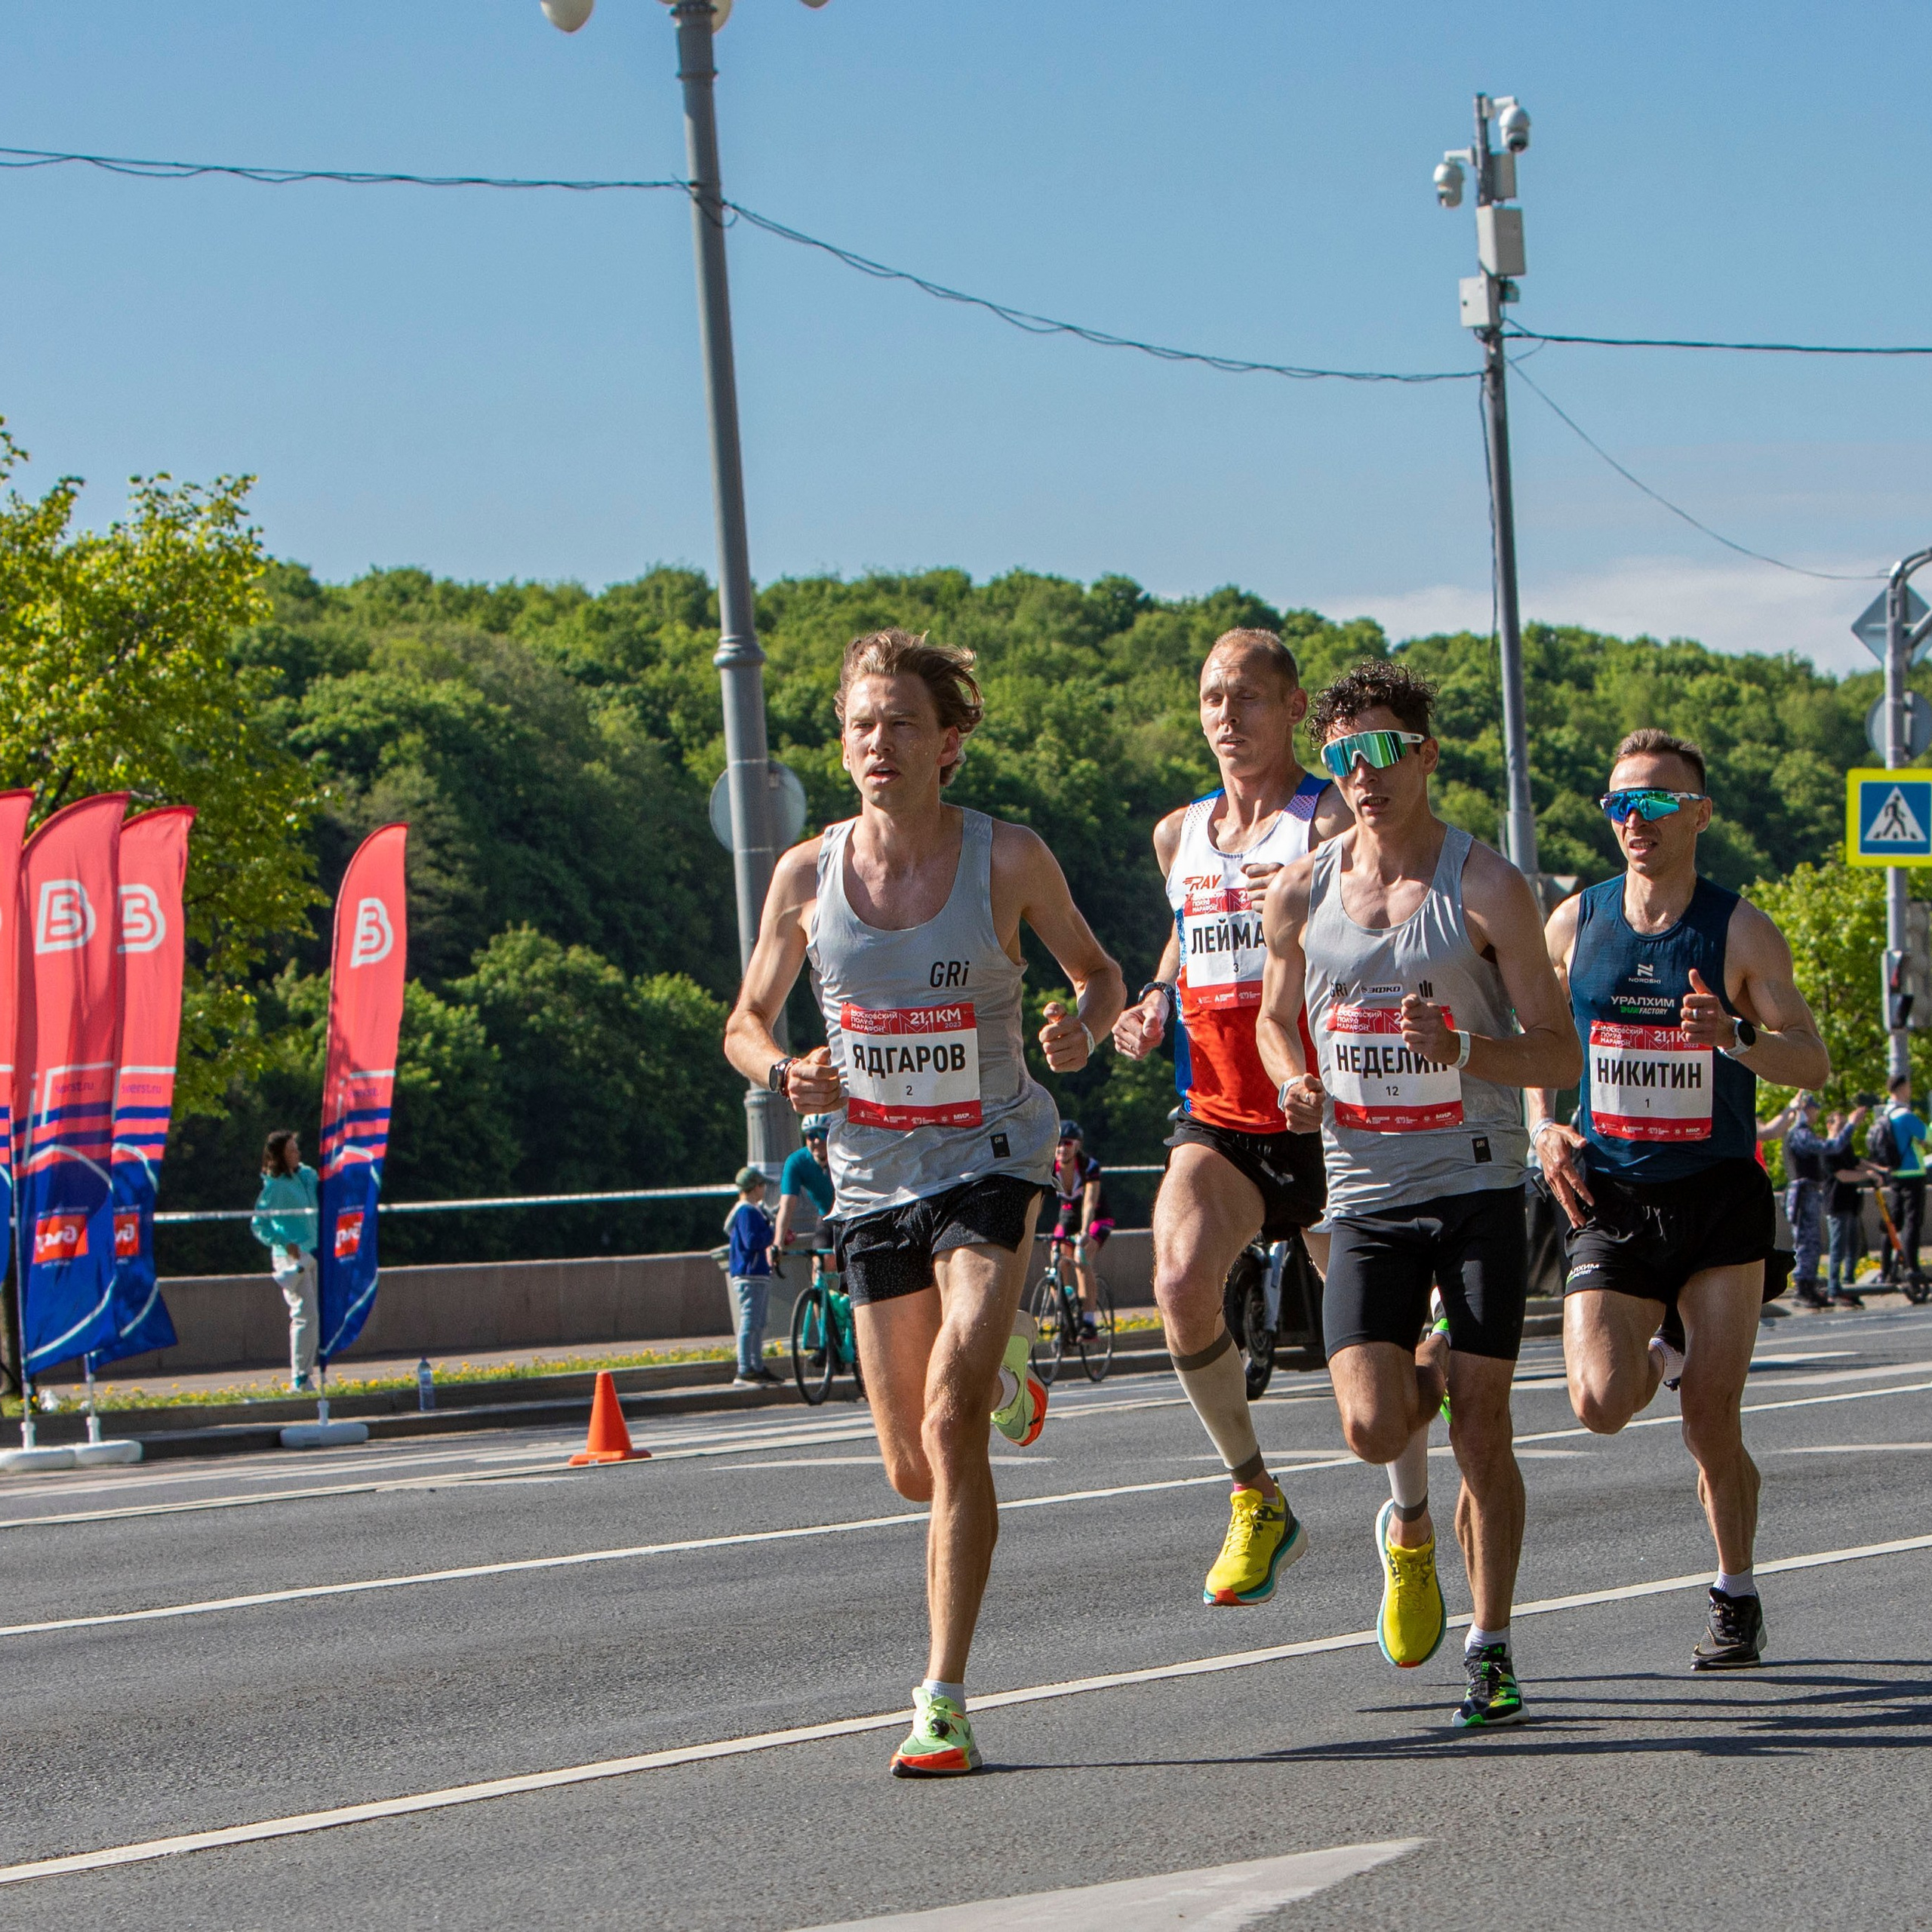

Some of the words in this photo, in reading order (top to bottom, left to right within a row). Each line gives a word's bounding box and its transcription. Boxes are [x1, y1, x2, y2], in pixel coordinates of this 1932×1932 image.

[1192, 918, 1268, 955] ЛЕЙМА
[1233, 963, 1239, 973] 3
[930, 961, 970, 988] GRi
[1611, 996, 1675, 1008] УРАЛХИМ
[853, 1043, 966, 1079] ЯДГАРОВ
[1598, 1057, 1702, 1089] НИКИТИН
[906, 1085, 913, 1096] 2
[1386, 1086, 1399, 1096] 12
[1645, 1098, 1650, 1108] 1
